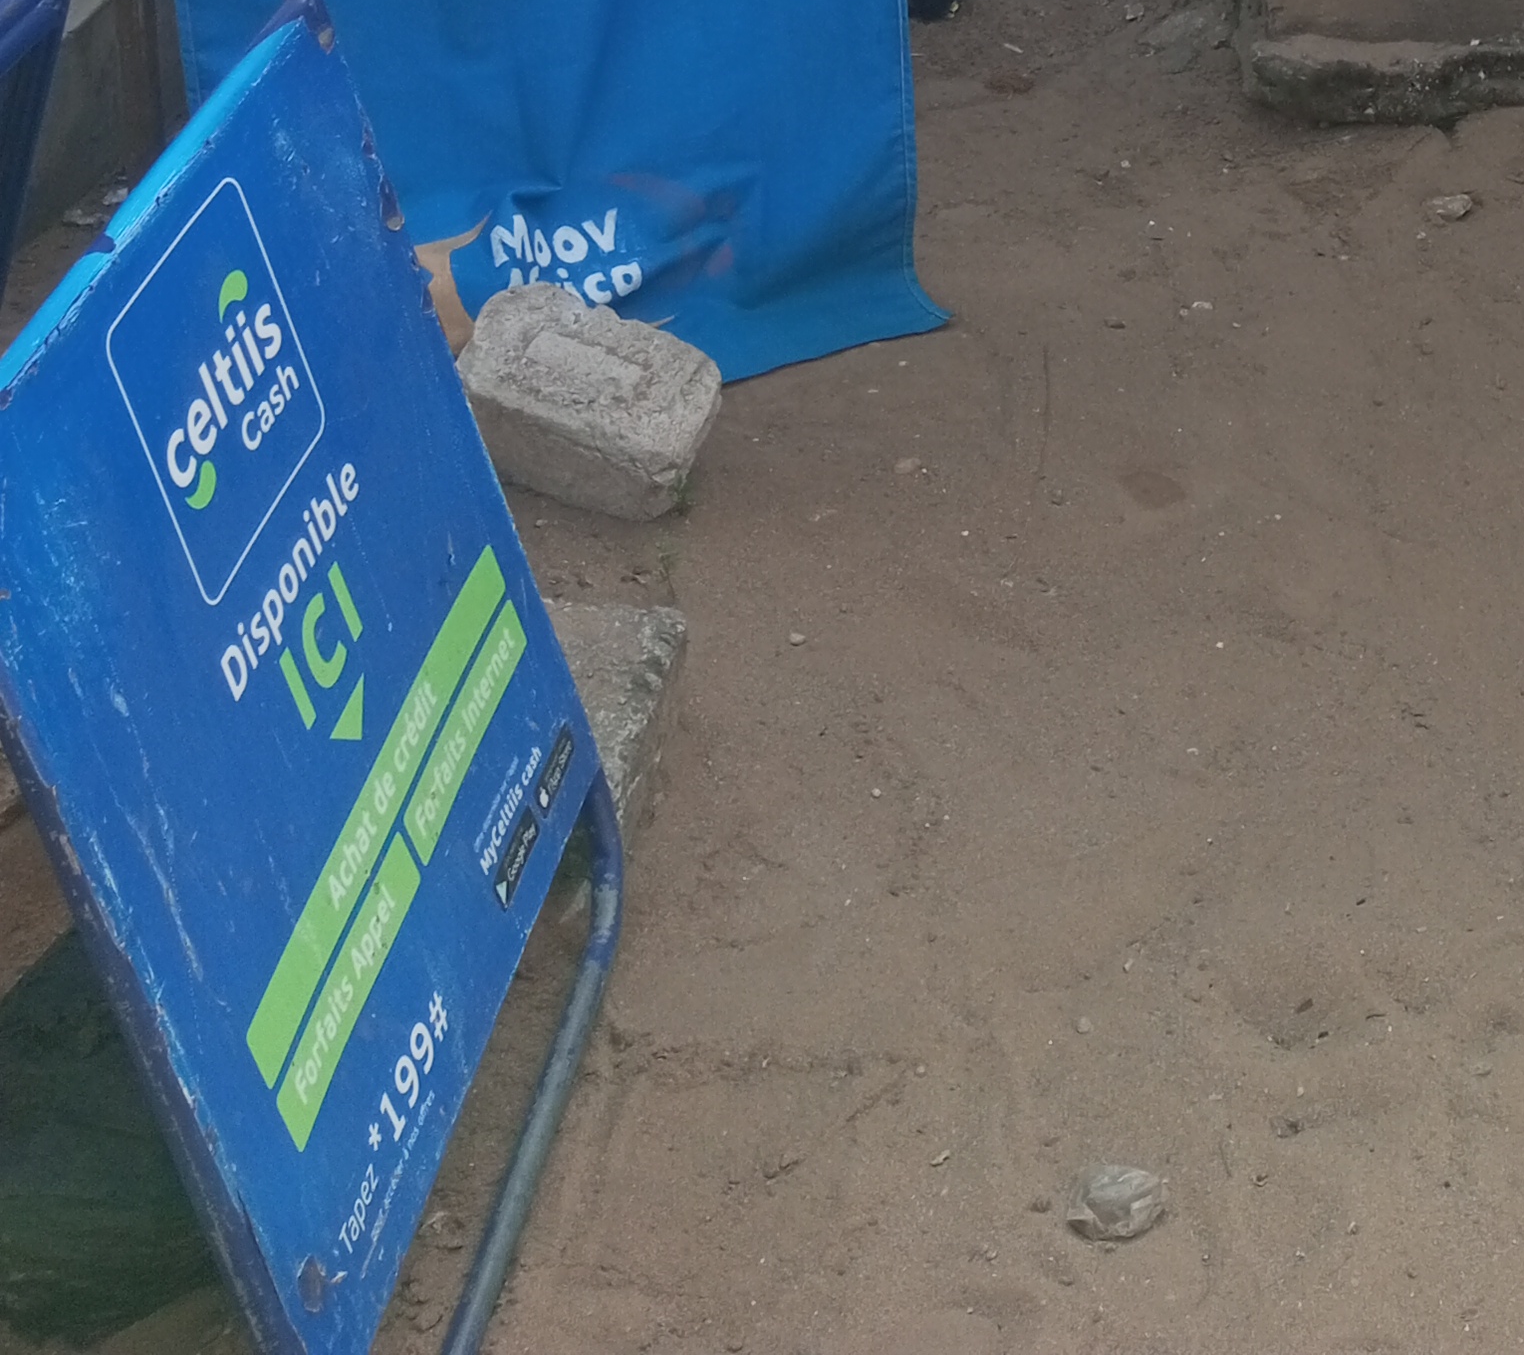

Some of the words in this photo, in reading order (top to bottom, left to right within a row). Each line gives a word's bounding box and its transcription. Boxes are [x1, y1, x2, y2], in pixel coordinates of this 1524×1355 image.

[490, 207, 618, 268] Moov
[507, 262, 643, 304] Aica
[166, 301, 284, 489] celtiis
[241, 363, 301, 451] Cash
[220, 462, 361, 702] Disponible
[279, 560, 364, 731] ICI
[327, 810, 378, 911] Achat
[373, 771, 397, 815] de
[394, 680, 438, 773] crédit
[414, 728, 467, 837] Forfaits
[461, 626, 516, 734] Internet
[479, 782, 523, 876] MyCeltiis
[521, 745, 543, 787] cash
[294, 972, 355, 1105] Forfaits
[350, 884, 397, 981] Appel
[338, 1162, 380, 1254] Tapez
